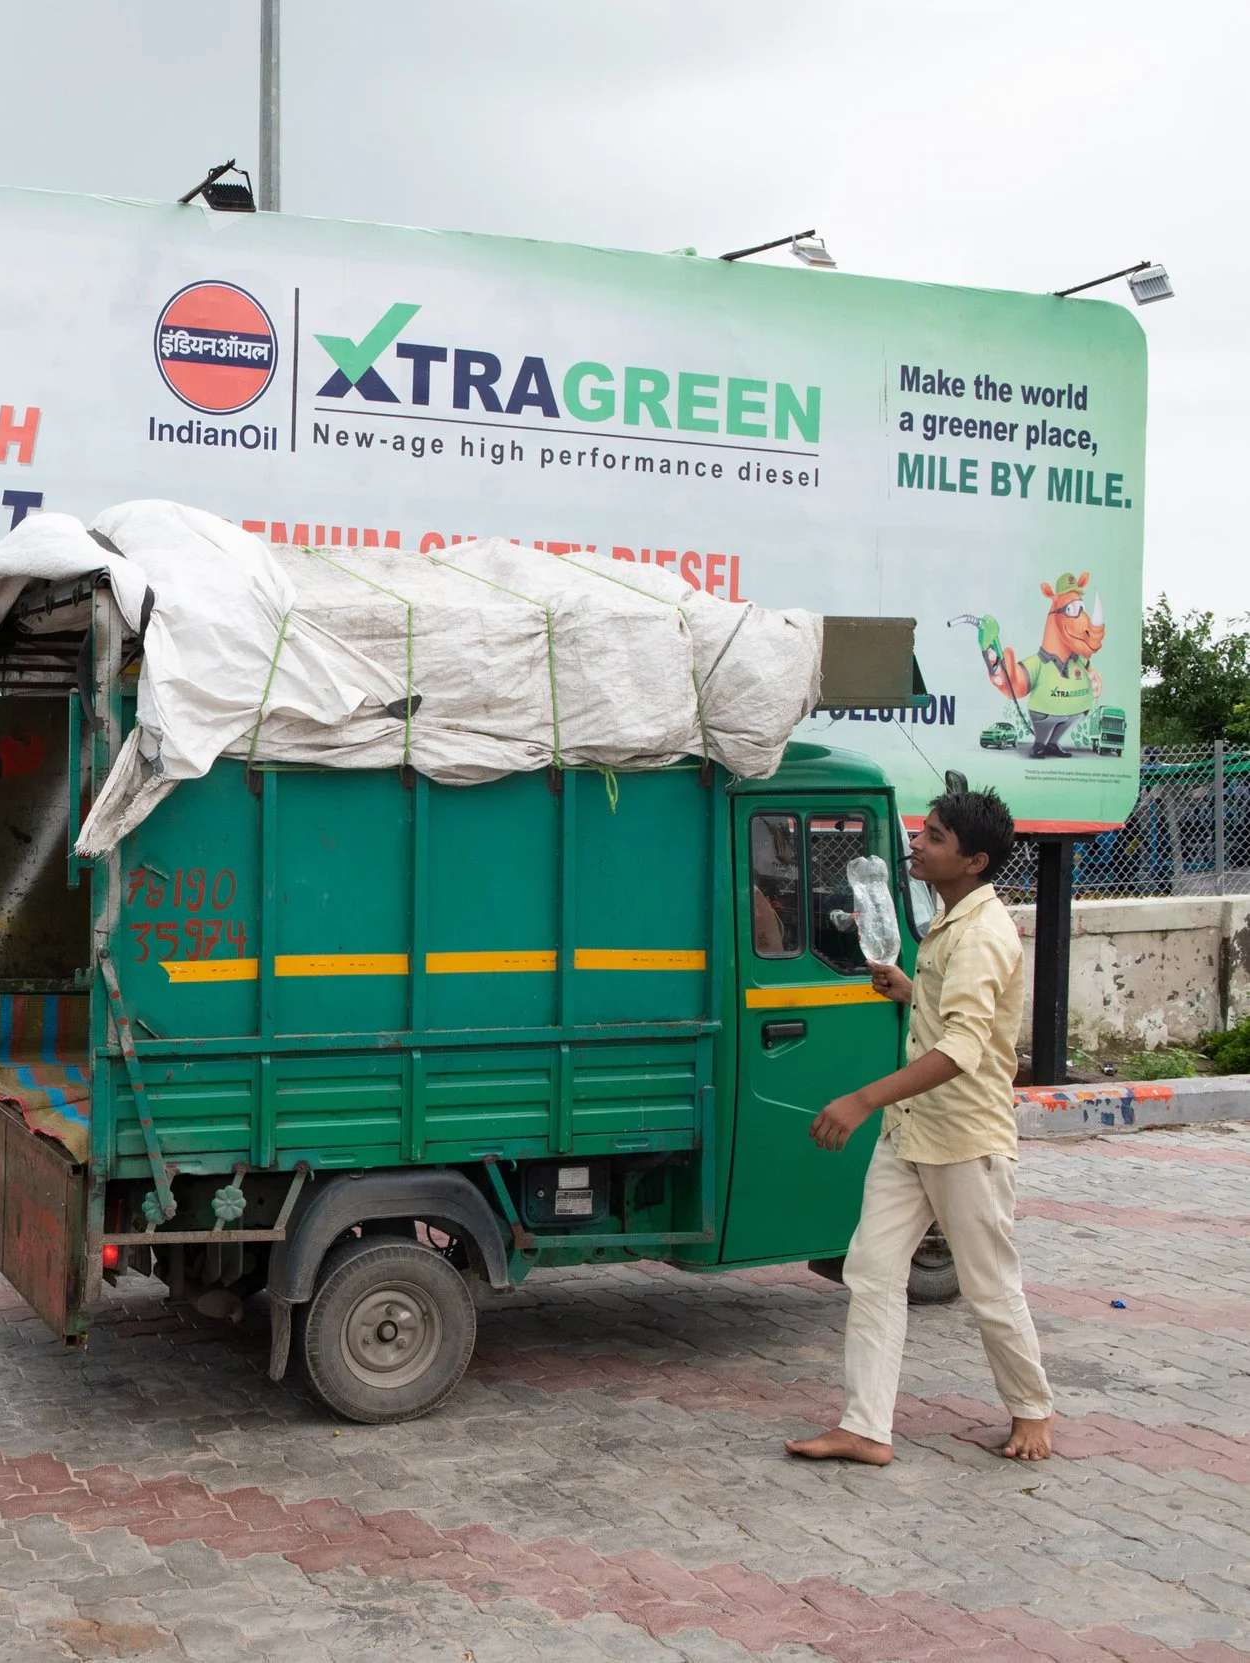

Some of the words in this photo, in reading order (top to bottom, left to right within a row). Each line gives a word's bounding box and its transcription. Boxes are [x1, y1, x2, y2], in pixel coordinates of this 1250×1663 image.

[161, 330, 271, 361] इंडियनऑयल
[313, 303, 821, 443] XTRAGREEN
[899, 364, 966, 397] Make
[973, 373, 1013, 403] the
[1020, 383, 1088, 411] world
[149, 416, 277, 450] IndianOil
[312, 422, 445, 458] New-age
[460, 435, 524, 465] high
[540, 446, 724, 480] performance
[737, 461, 820, 488] diesel
[898, 411, 914, 432] a
[922, 411, 1019, 442] greener
[1025, 419, 1098, 456] place,
[897, 452, 979, 494] MILE
[990, 461, 1037, 499] BY
[1047, 466, 1133, 509] MILE.
[128, 918, 248, 964] 35974
